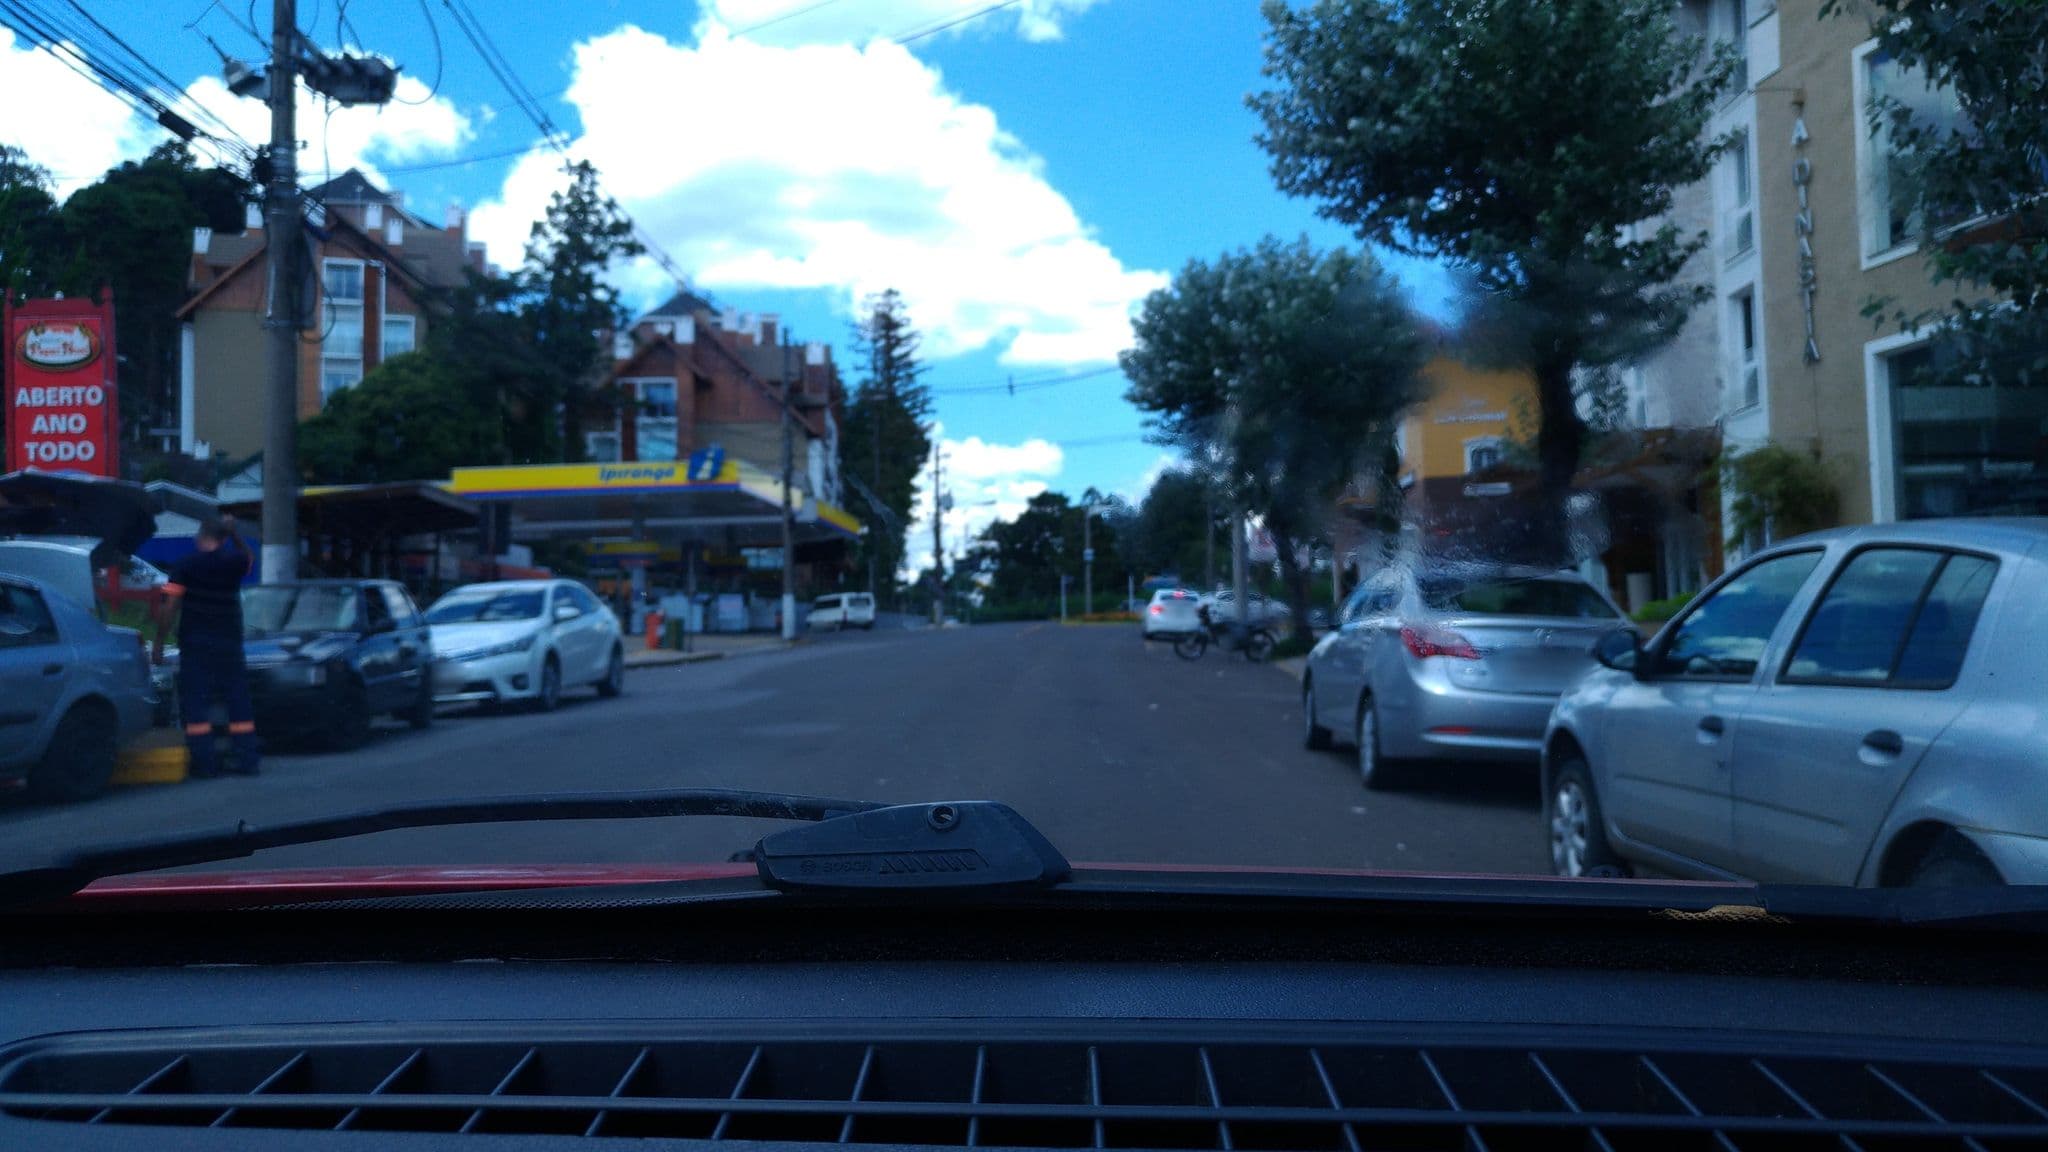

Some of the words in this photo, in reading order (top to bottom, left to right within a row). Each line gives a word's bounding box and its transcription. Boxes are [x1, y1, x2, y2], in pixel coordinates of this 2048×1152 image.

[16, 386, 103, 407] ABERTO
[32, 414, 87, 434] ANO
[25, 442, 95, 462] TODO
